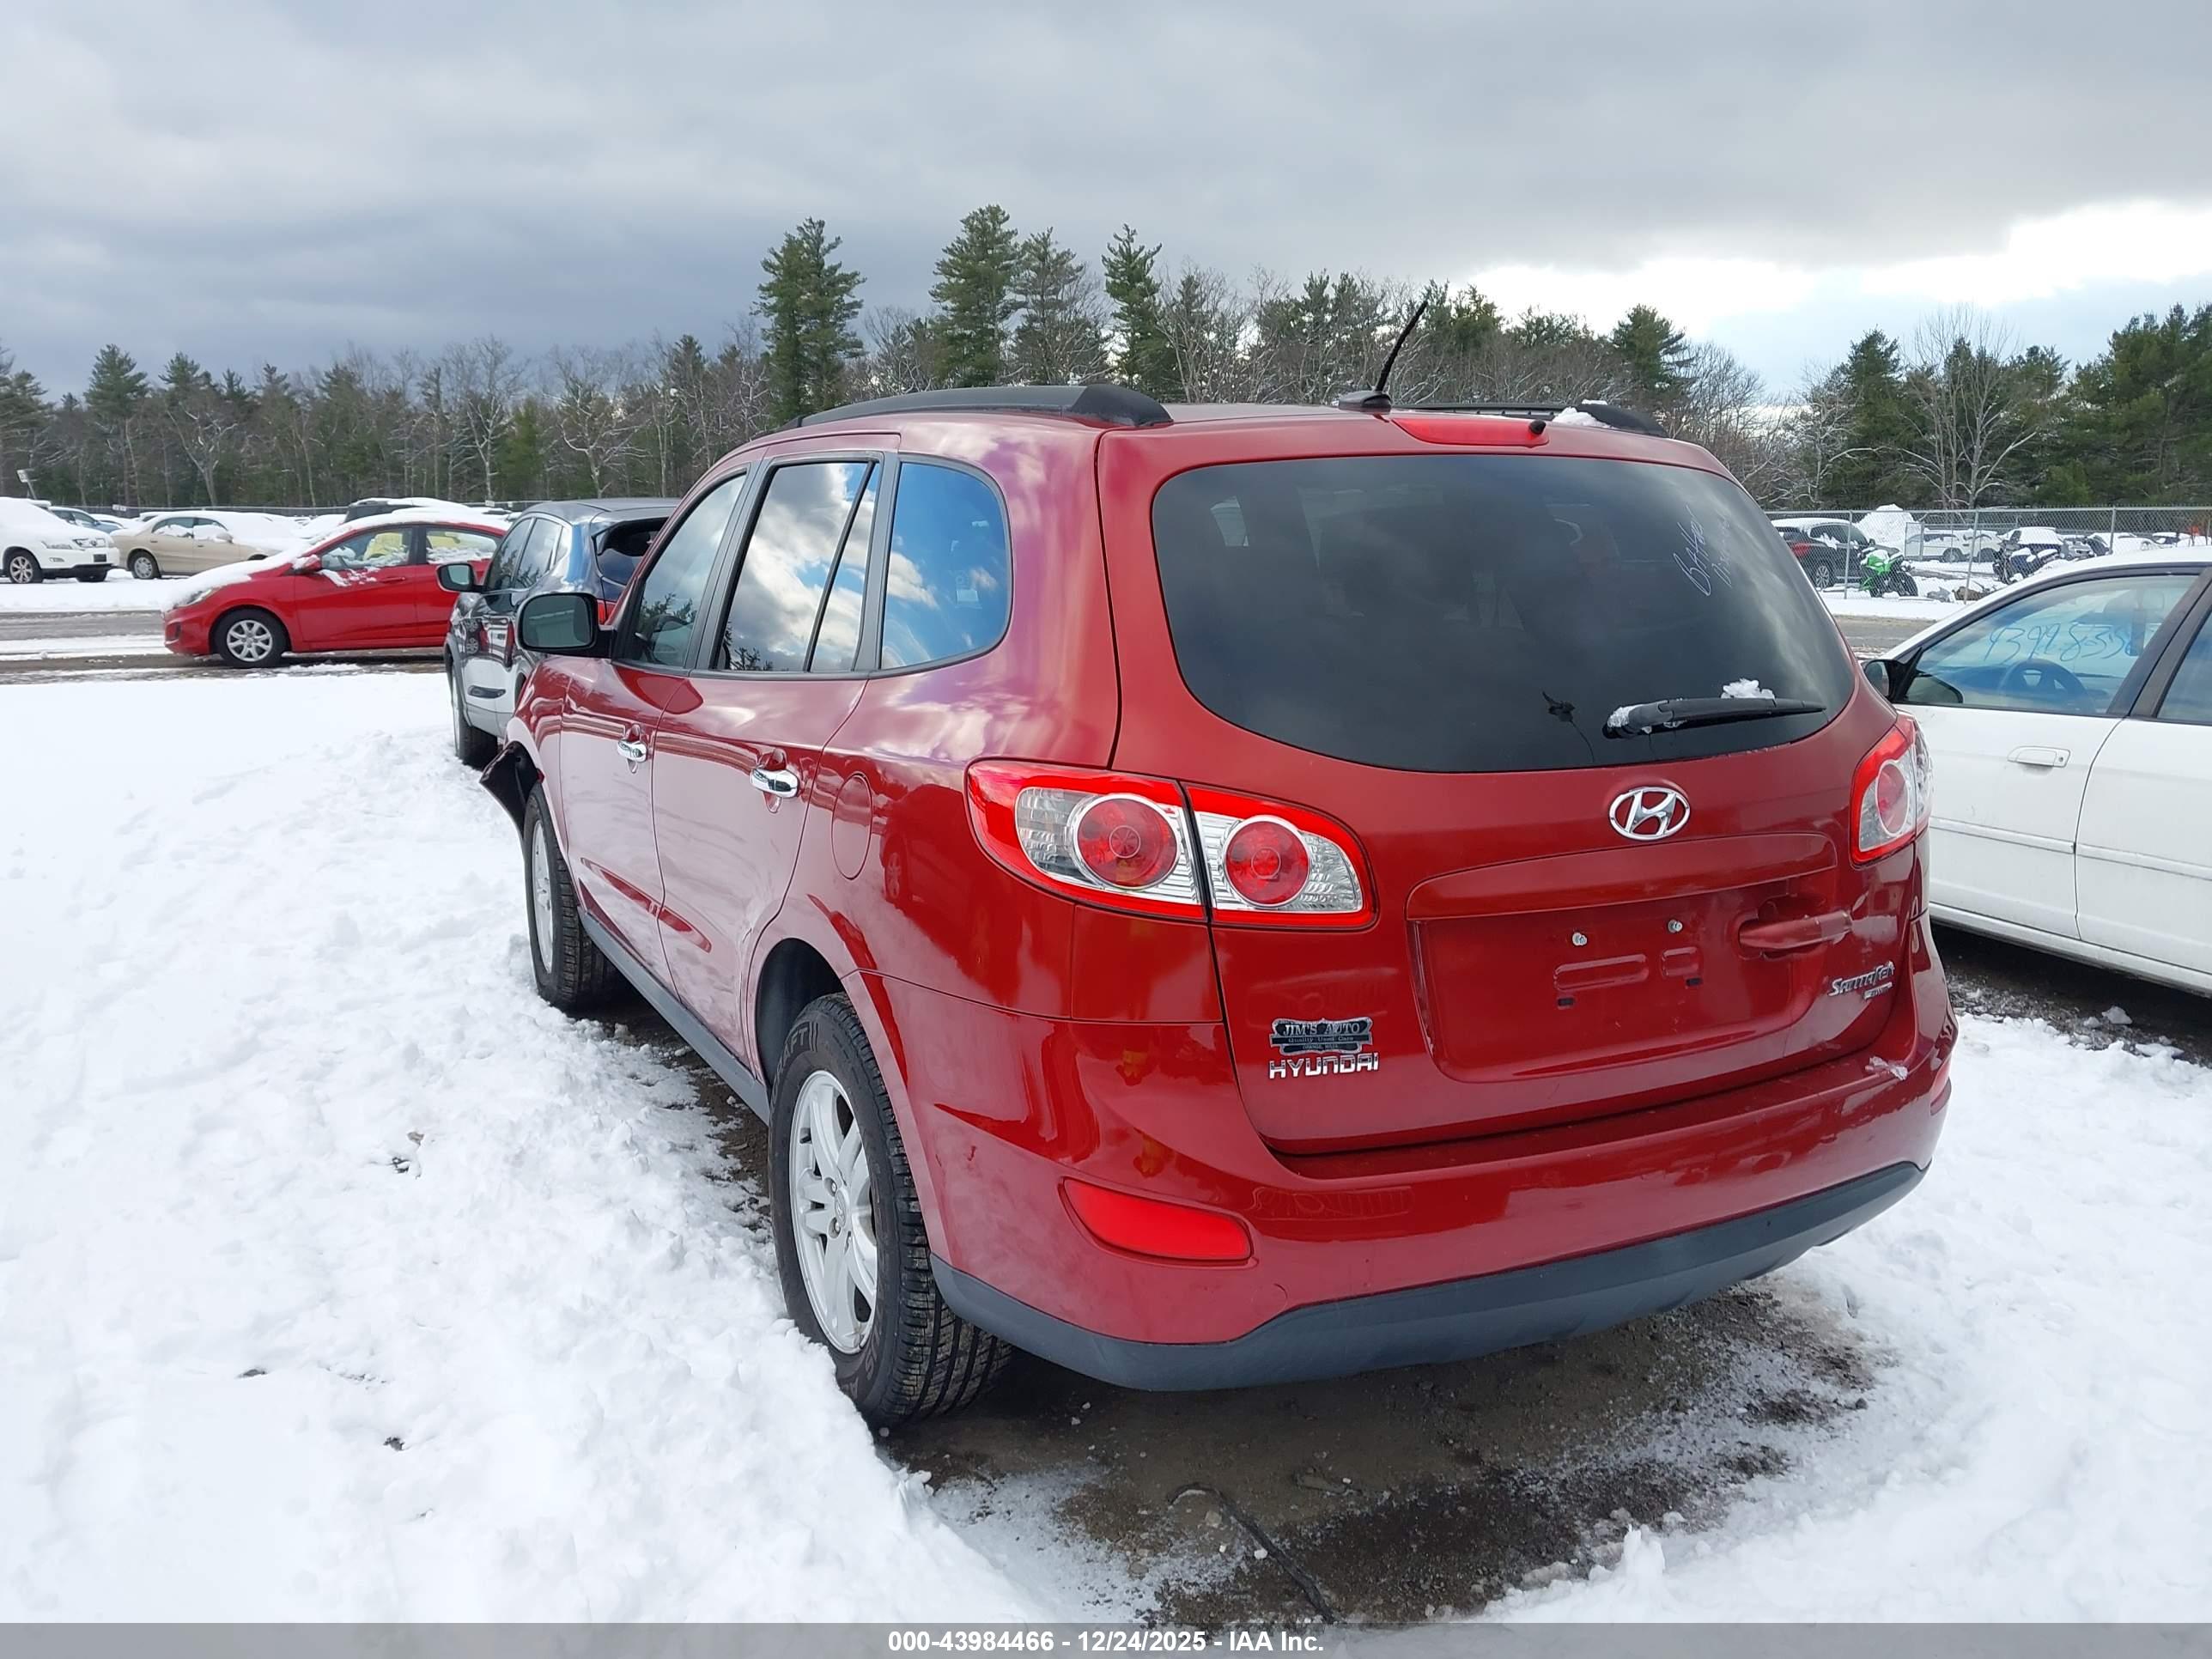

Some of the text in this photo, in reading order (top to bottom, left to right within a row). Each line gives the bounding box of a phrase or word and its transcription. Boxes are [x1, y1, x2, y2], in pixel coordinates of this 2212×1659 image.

[1283, 1023, 1360, 1036] JIM'S AUTO
[1288, 1036, 1314, 1044] Quality
[1269, 1052, 1379, 1079] HYUNDAI
